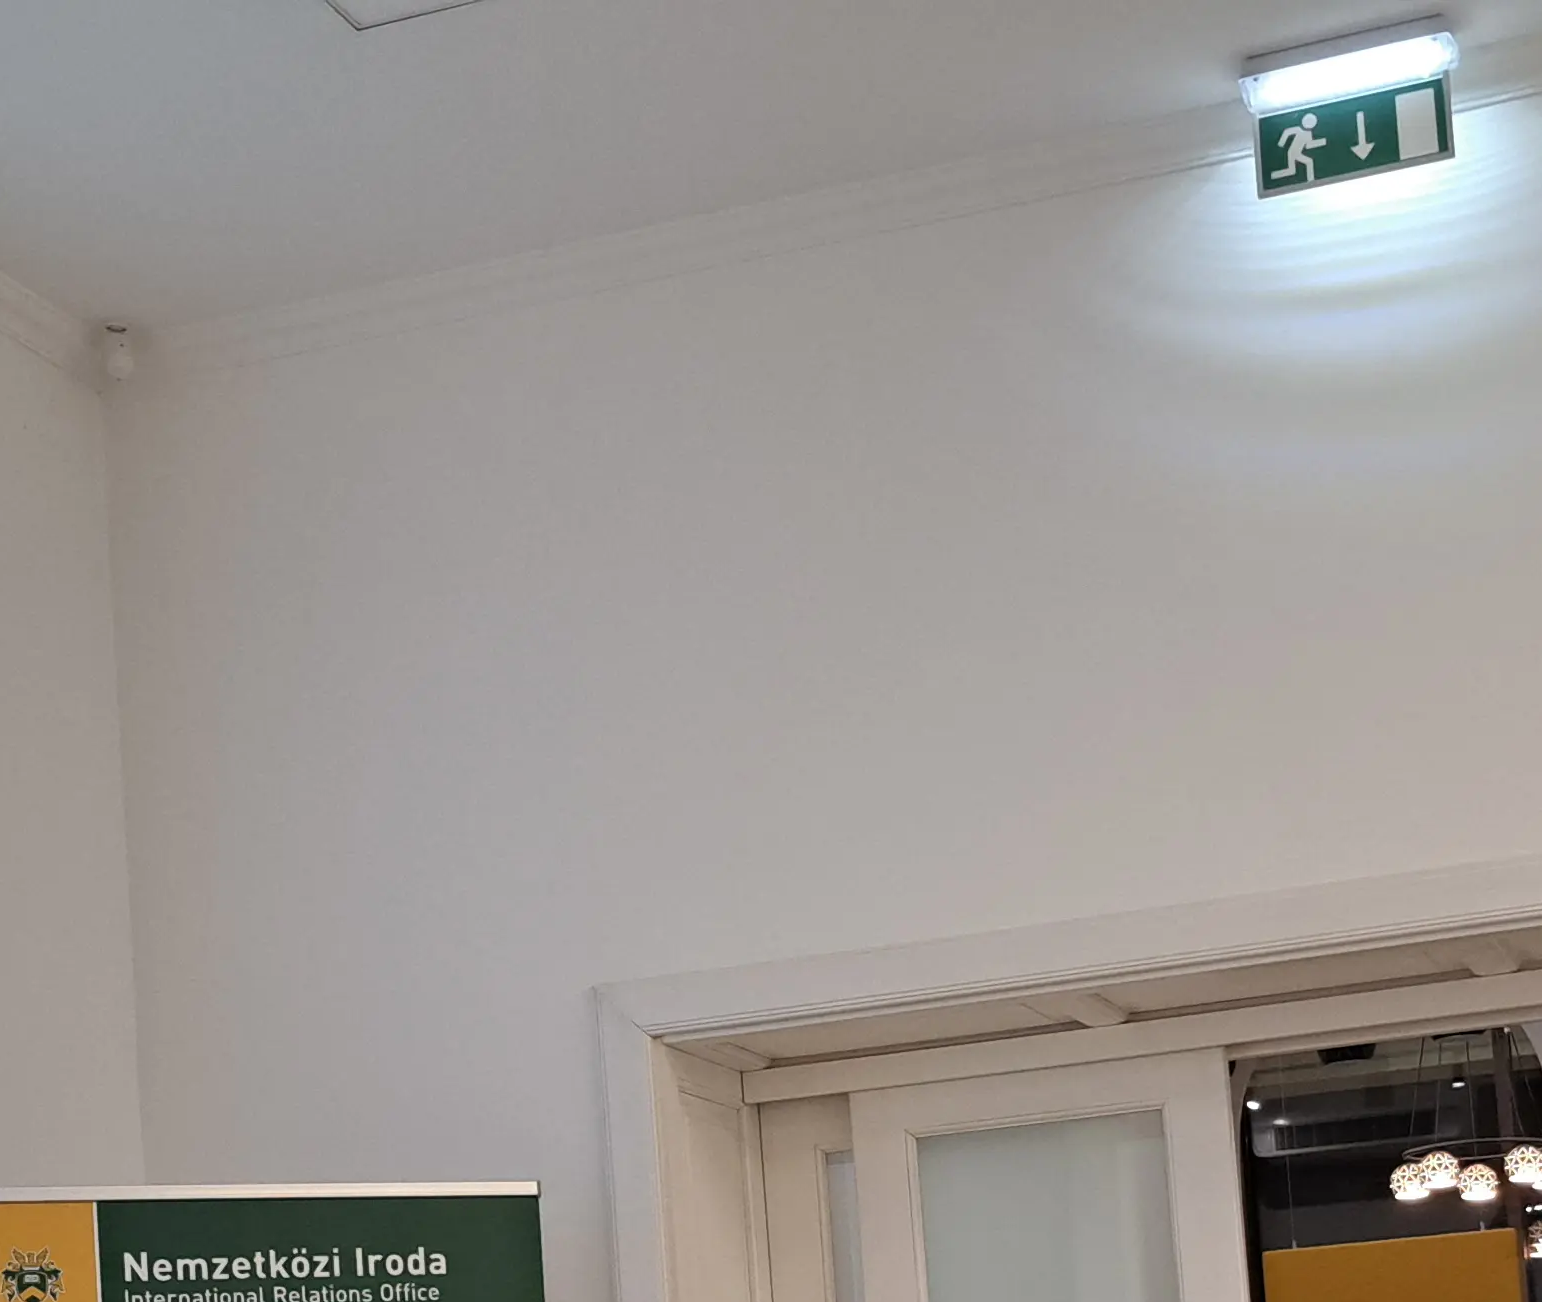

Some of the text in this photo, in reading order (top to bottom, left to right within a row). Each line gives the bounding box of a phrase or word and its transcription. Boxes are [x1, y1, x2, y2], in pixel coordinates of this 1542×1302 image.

[123, 1246, 447, 1282] Nemzetközi Iroda
[380, 1282, 440, 1302] Office
